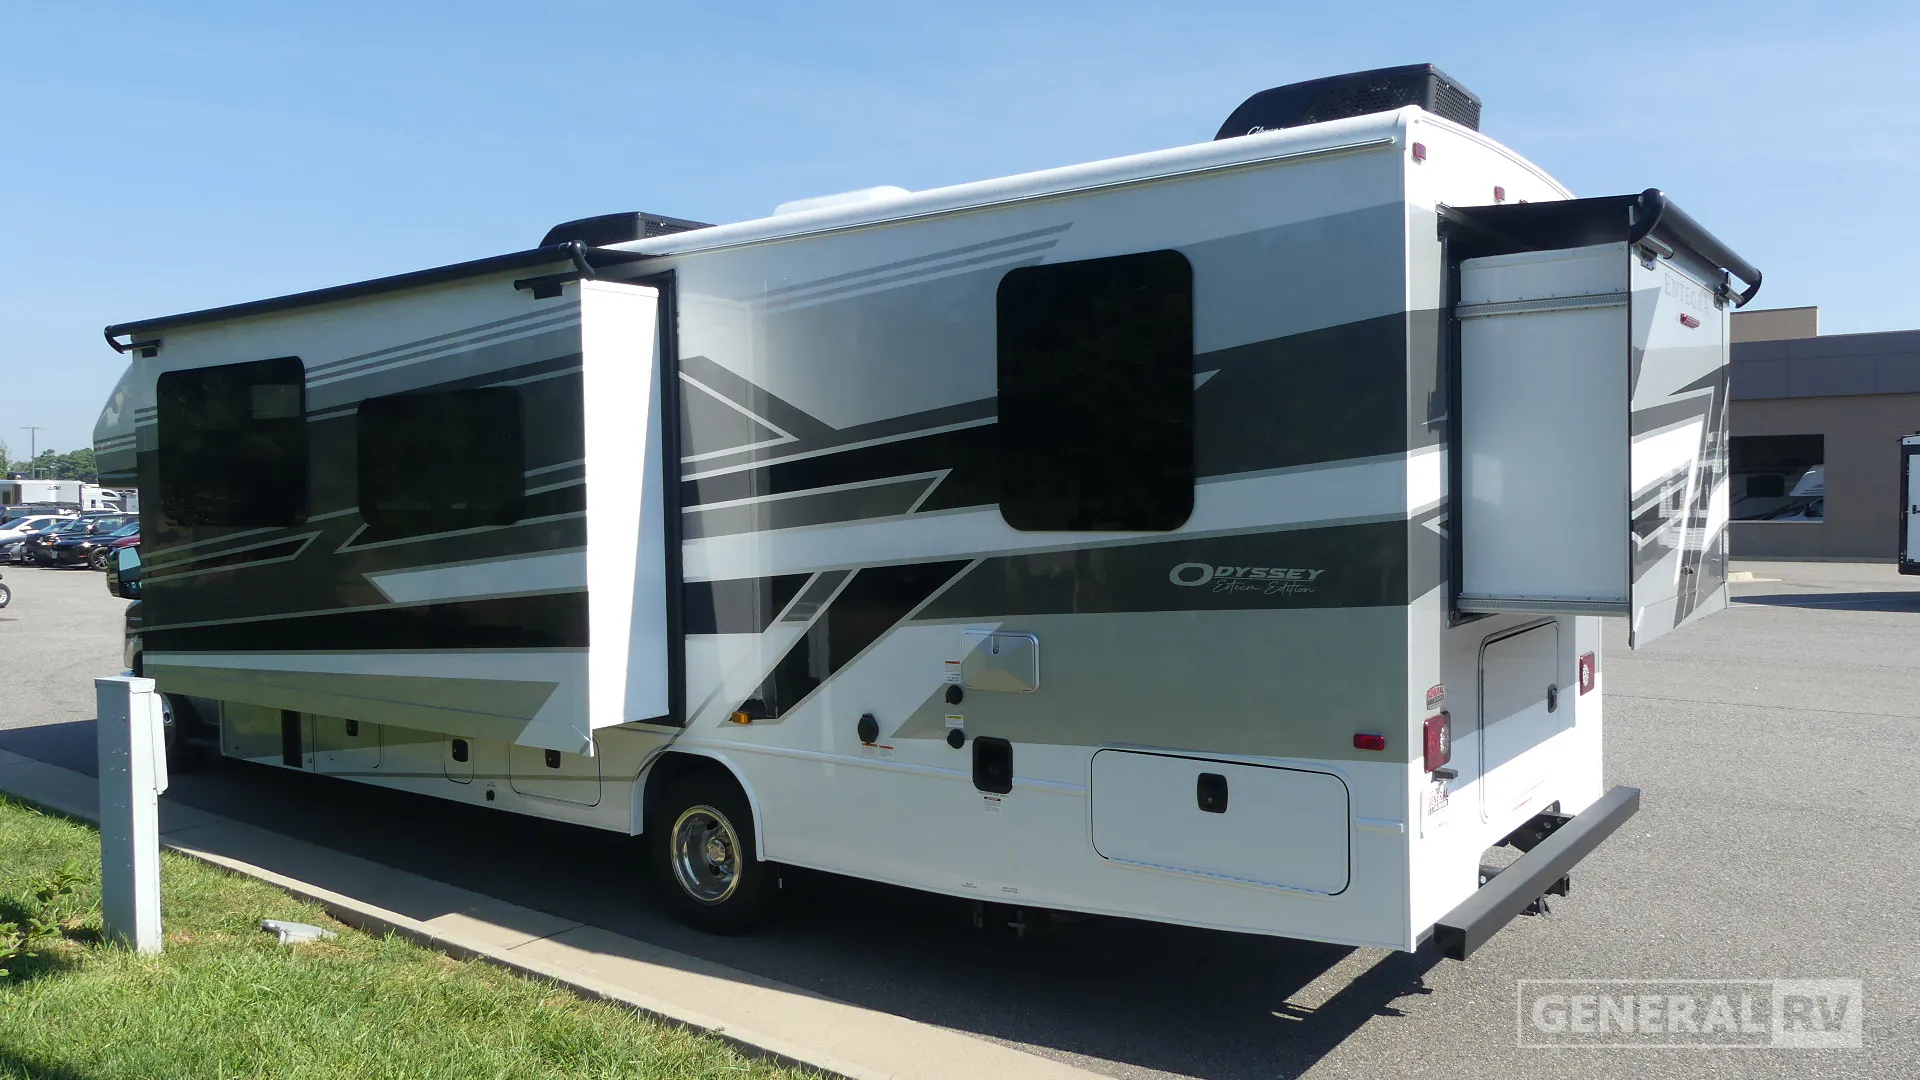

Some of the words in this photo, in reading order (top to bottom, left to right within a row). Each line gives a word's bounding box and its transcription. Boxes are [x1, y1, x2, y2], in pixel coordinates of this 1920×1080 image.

[1663, 273, 1709, 316] ENTEGRA
[1169, 562, 1326, 587] ODYSSEY
[1264, 581, 1315, 597] Edition
